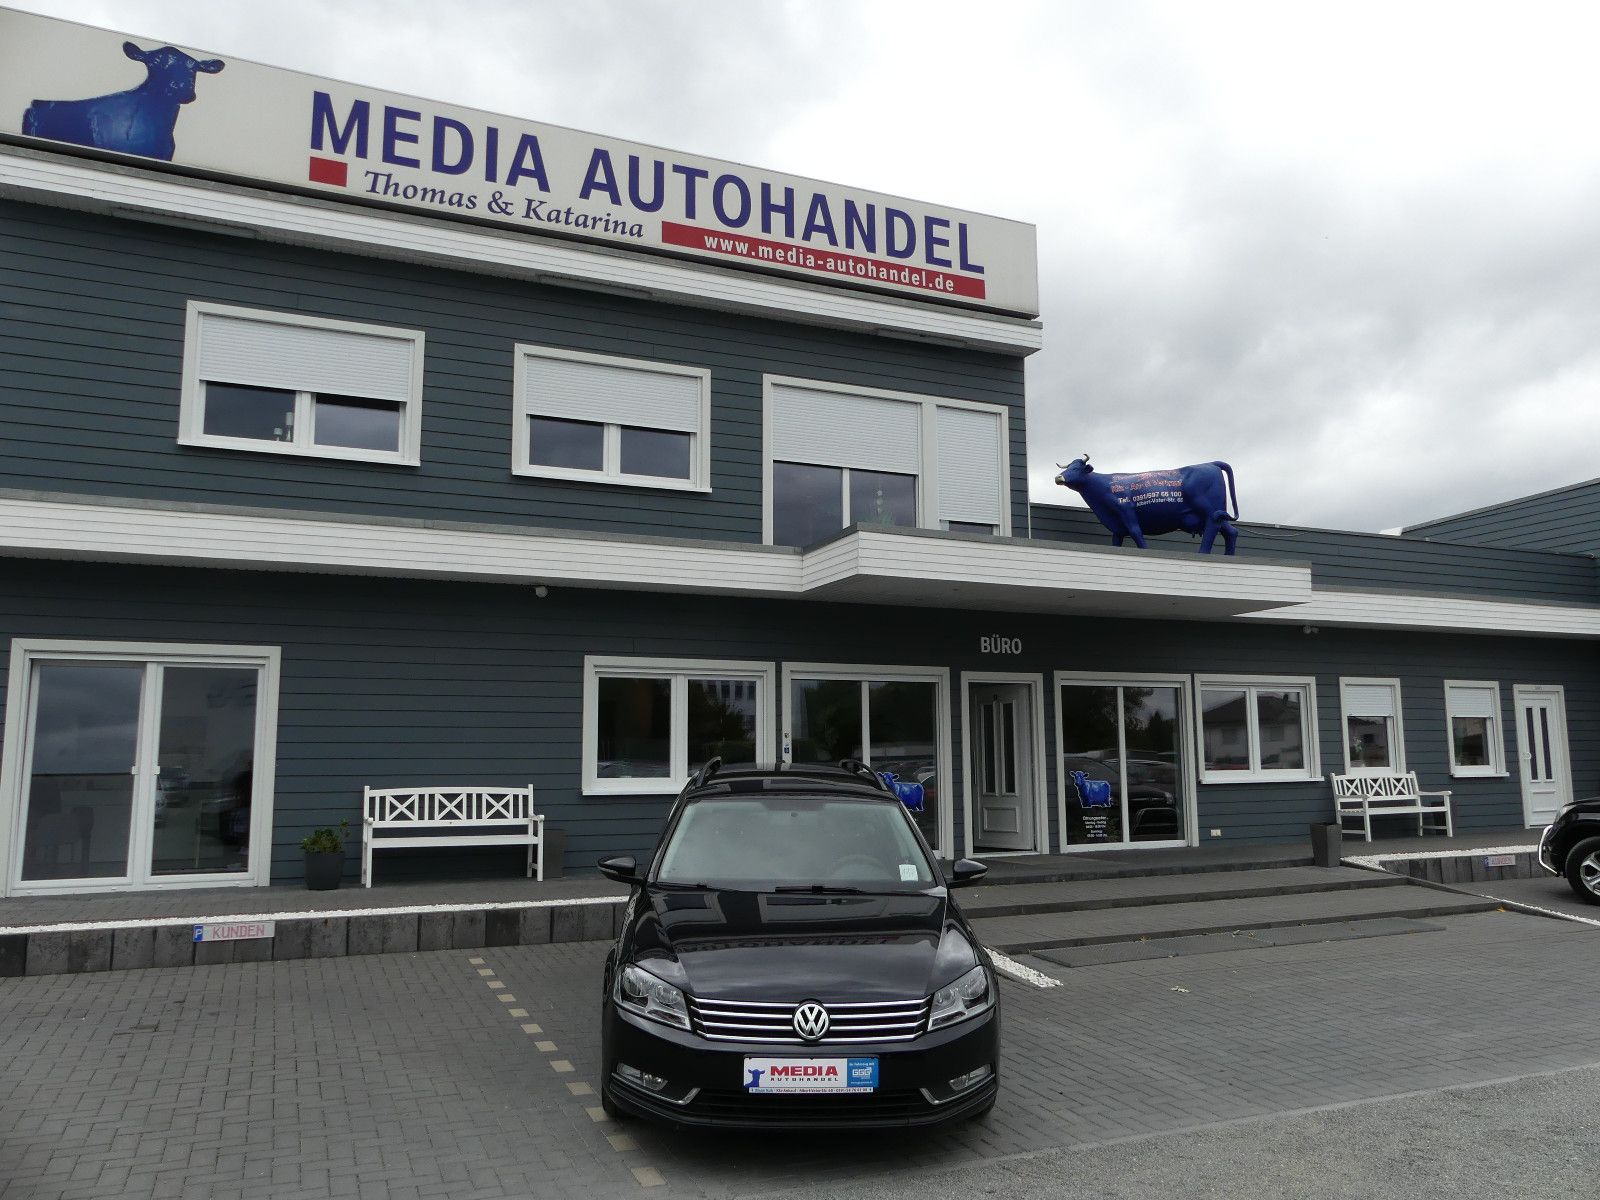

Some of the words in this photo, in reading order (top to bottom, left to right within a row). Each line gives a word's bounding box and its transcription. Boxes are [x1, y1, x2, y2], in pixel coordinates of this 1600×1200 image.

[310, 90, 551, 193] MEDIA
[578, 147, 985, 275] AUTOHANDEL
[364, 170, 478, 209] Thomas
[487, 190, 514, 216] &
[521, 197, 645, 238] Katarina
[703, 235, 955, 292] www.media-autohandel.de
[980, 633, 1022, 655] BÜRO
[212, 924, 265, 939] KUNDEN
[770, 1065, 838, 1076] MEDIA
